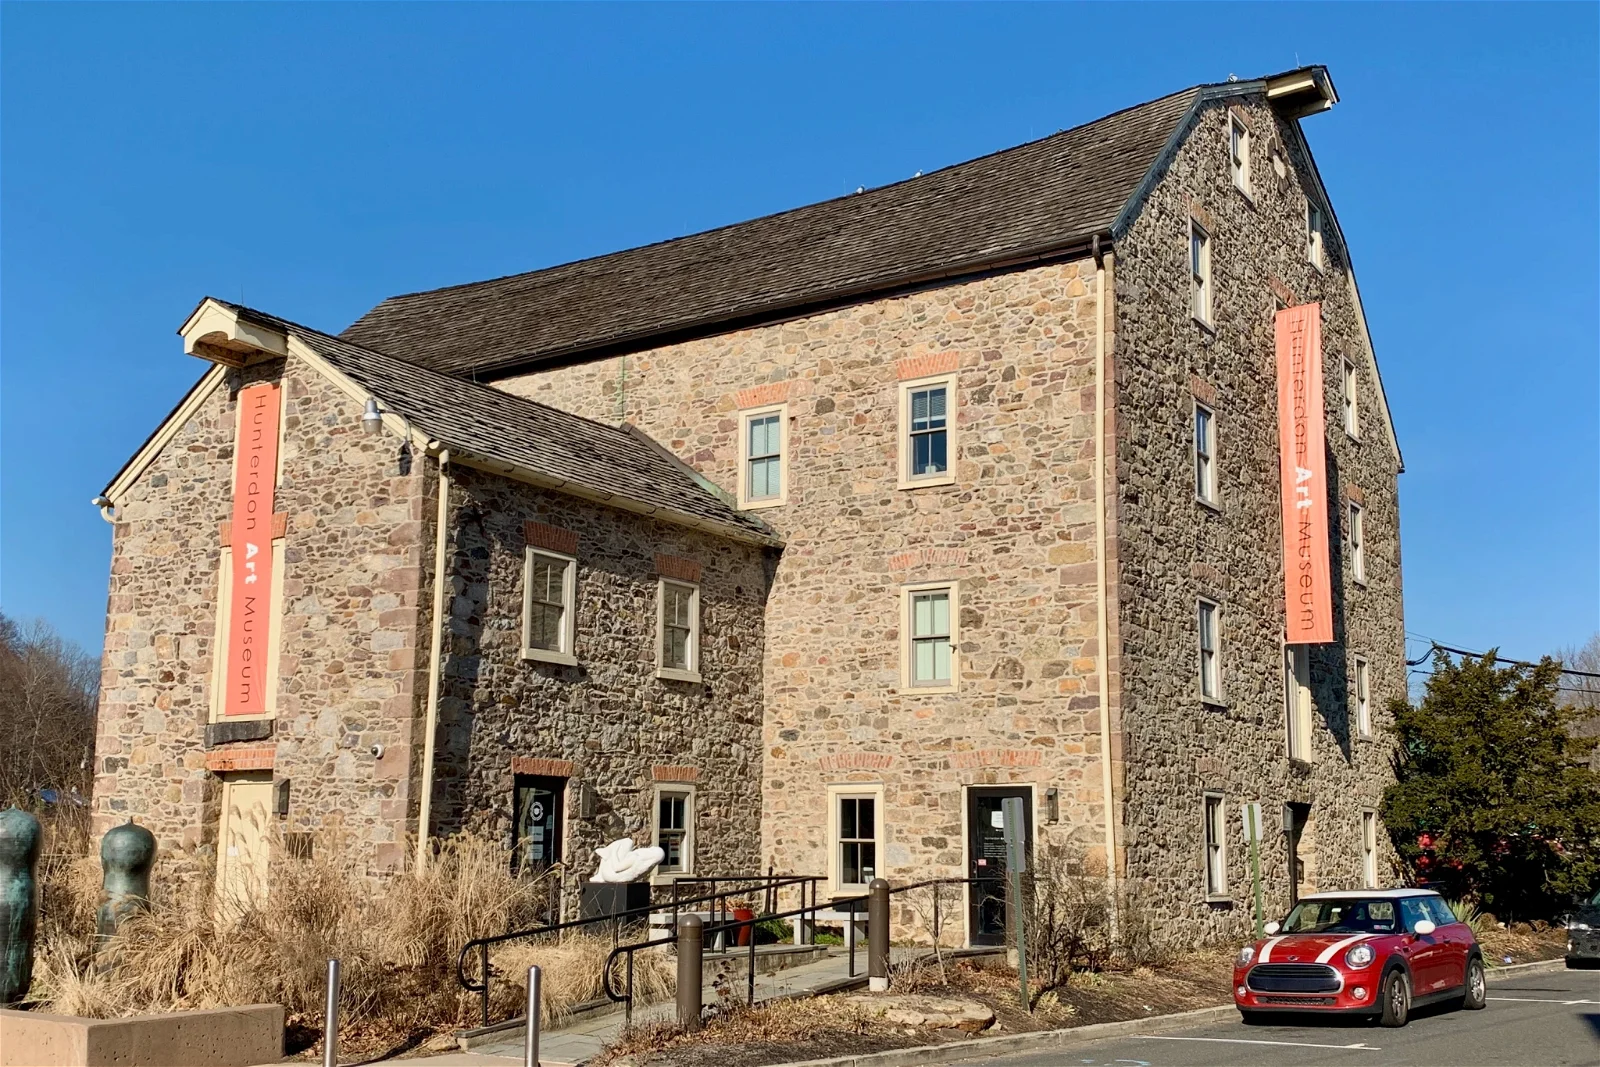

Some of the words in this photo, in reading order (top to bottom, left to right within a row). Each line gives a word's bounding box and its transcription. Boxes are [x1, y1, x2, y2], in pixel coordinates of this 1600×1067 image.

[1289, 318, 1310, 455] Hunterdon
[245, 394, 268, 531] Hunterdon
[1294, 466, 1313, 509] Art
[244, 542, 259, 585] Art
[1298, 521, 1315, 631] Museum
[239, 596, 257, 704] Museum
